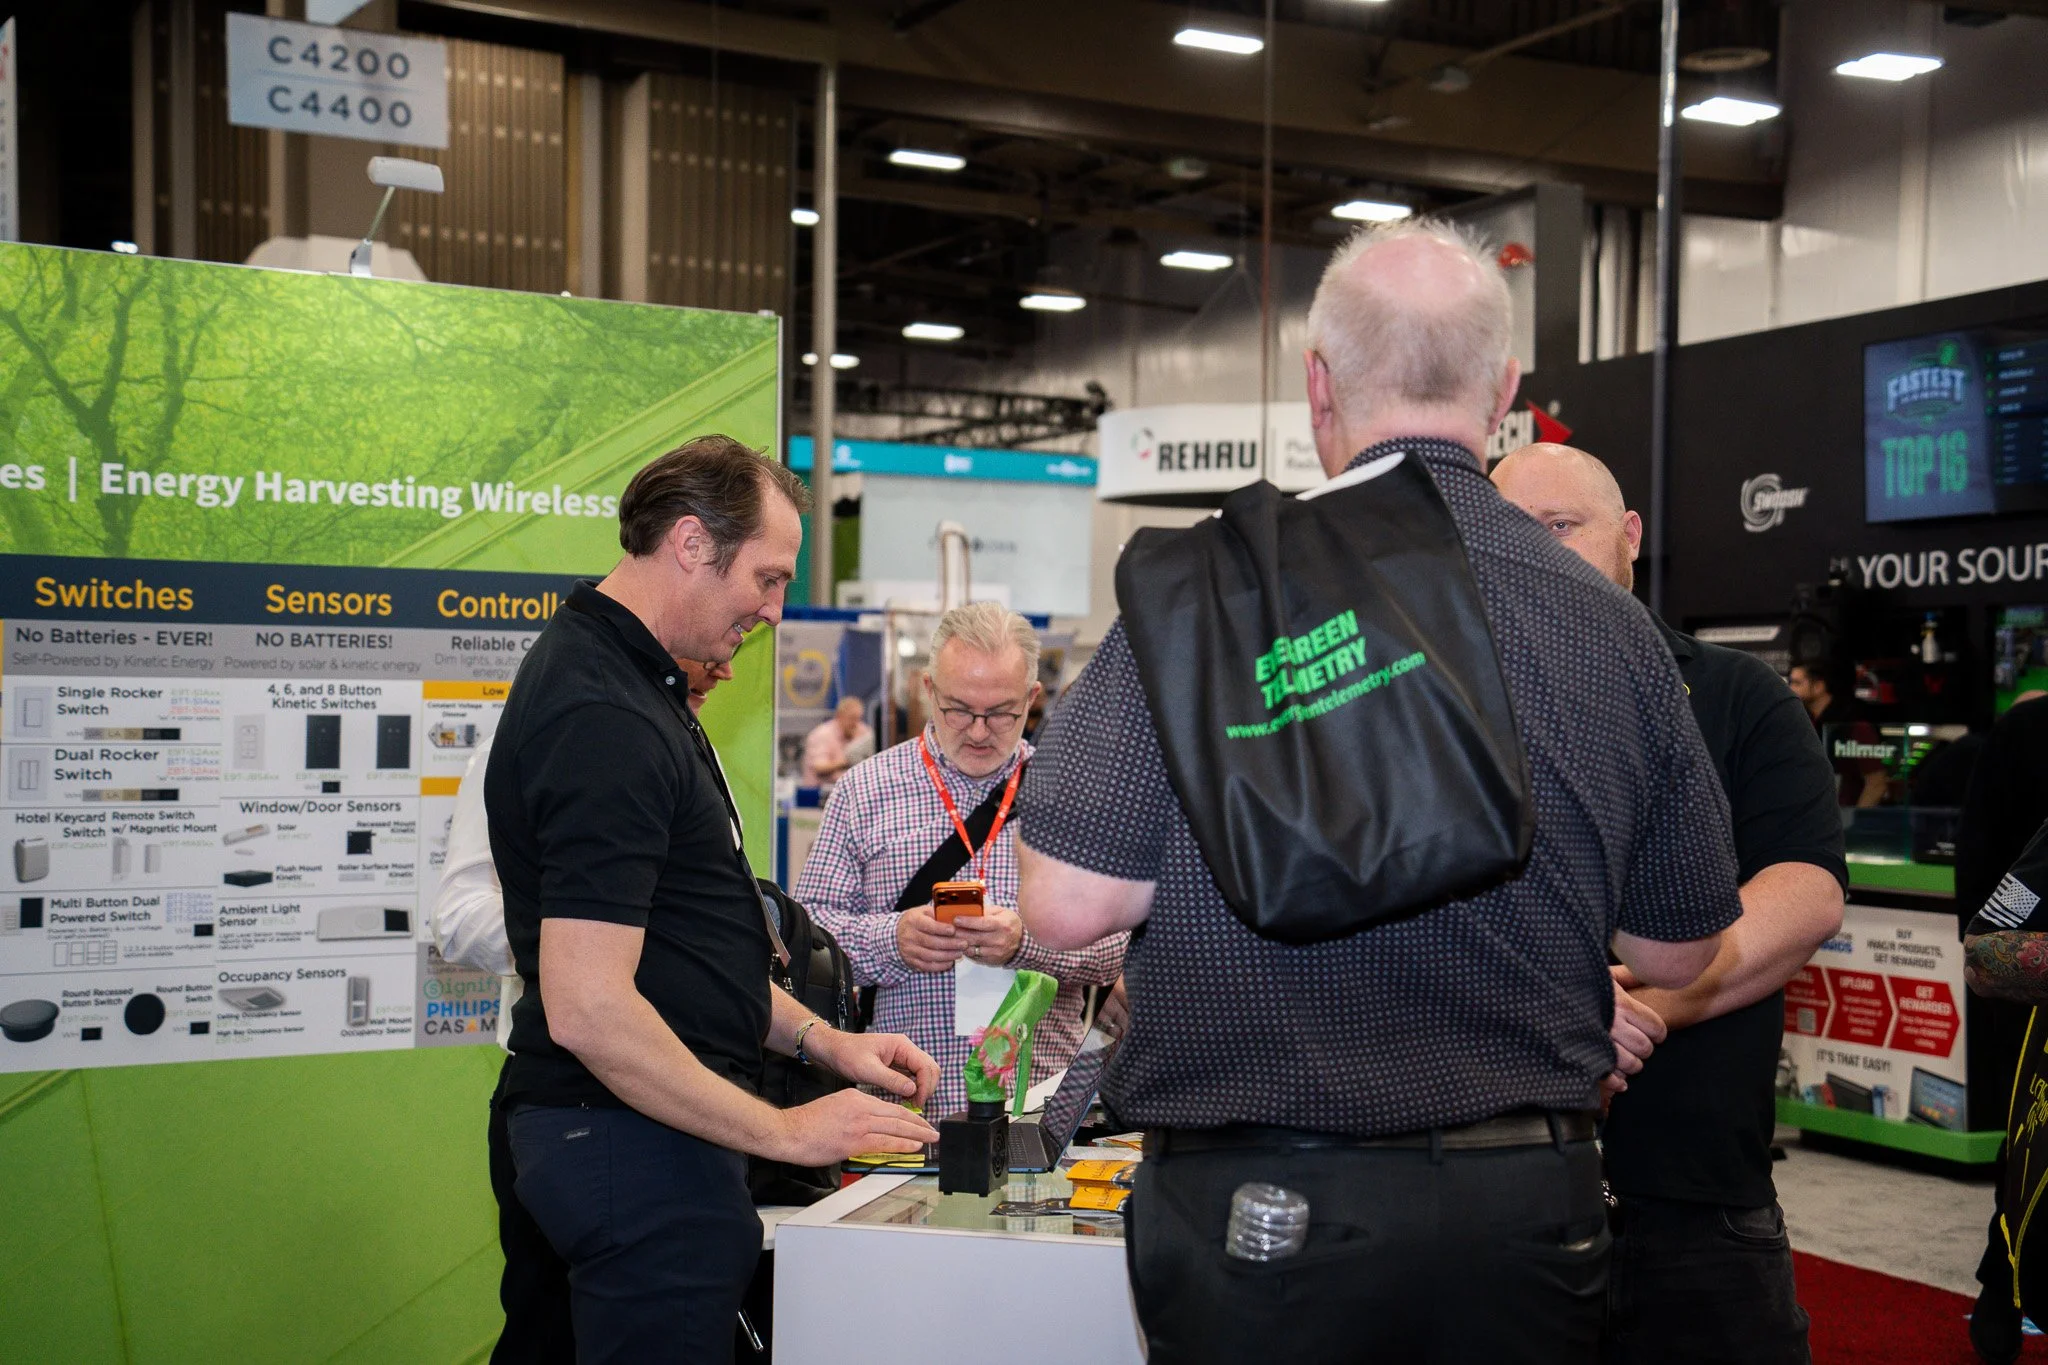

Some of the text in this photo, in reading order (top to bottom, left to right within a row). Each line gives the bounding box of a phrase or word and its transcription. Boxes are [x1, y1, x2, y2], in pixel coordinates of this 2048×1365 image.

[267, 36, 411, 79] C4200
[266, 85, 413, 127] C4400
[1158, 440, 1257, 472] REHAU
[1881, 434, 1935, 499] TOP
[101, 462, 244, 507] Energy
[256, 470, 462, 518] Harvesting
[470, 480, 618, 518] Wireless
[1857, 550, 1950, 589] YOUR
[34, 576, 195, 612] Switches
[265, 583, 393, 617] Sensors
[437, 589, 557, 621] Controll
[16, 628, 44, 643] No
[50, 628, 137, 645] Batteries
[156, 630, 213, 647] EVER!
[256, 632, 393, 649] NO BATTERIES!
[451, 636, 516, 651] Reliable
[13, 651, 214, 671] Self-Powered by Kinetic Energy
[223, 656, 421, 674] Powered by solar & kinetic energy
[434, 652, 455, 666] Dim
[495, 655, 519, 667] auto
[472, 668, 511, 681] energy
[57, 686, 164, 700] Single Rocker
[267, 684, 382, 699] 4, 6, and 8 Button
[482, 686, 504, 697] Low
[57, 703, 109, 716] Switch
[271, 698, 377, 711] Kinetic Switches
[54, 748, 159, 762] Dual Rocker
[54, 767, 112, 781] Switch
[240, 800, 402, 814] Window/Door Sensors
[15, 811, 106, 825] Hotel Keycard
[112, 810, 195, 821] Remote Switch
[63, 826, 106, 838] Switch
[112, 823, 218, 835] w/ Magnetic Mount
[277, 823, 297, 831] Solar
[50, 896, 160, 909] Multi Button Dual
[219, 903, 301, 916] Ambient Light
[50, 910, 151, 924] Powered Switch
[219, 916, 257, 928] Sensor
[218, 967, 347, 984] Occupancy Sensors
[62, 987, 134, 998] Round Recessed
[156, 984, 213, 994] Round Button
[62, 998, 123, 1008] Button Switch
[185, 995, 213, 1003] Switch
[426, 999, 500, 1018] PHILIPS
